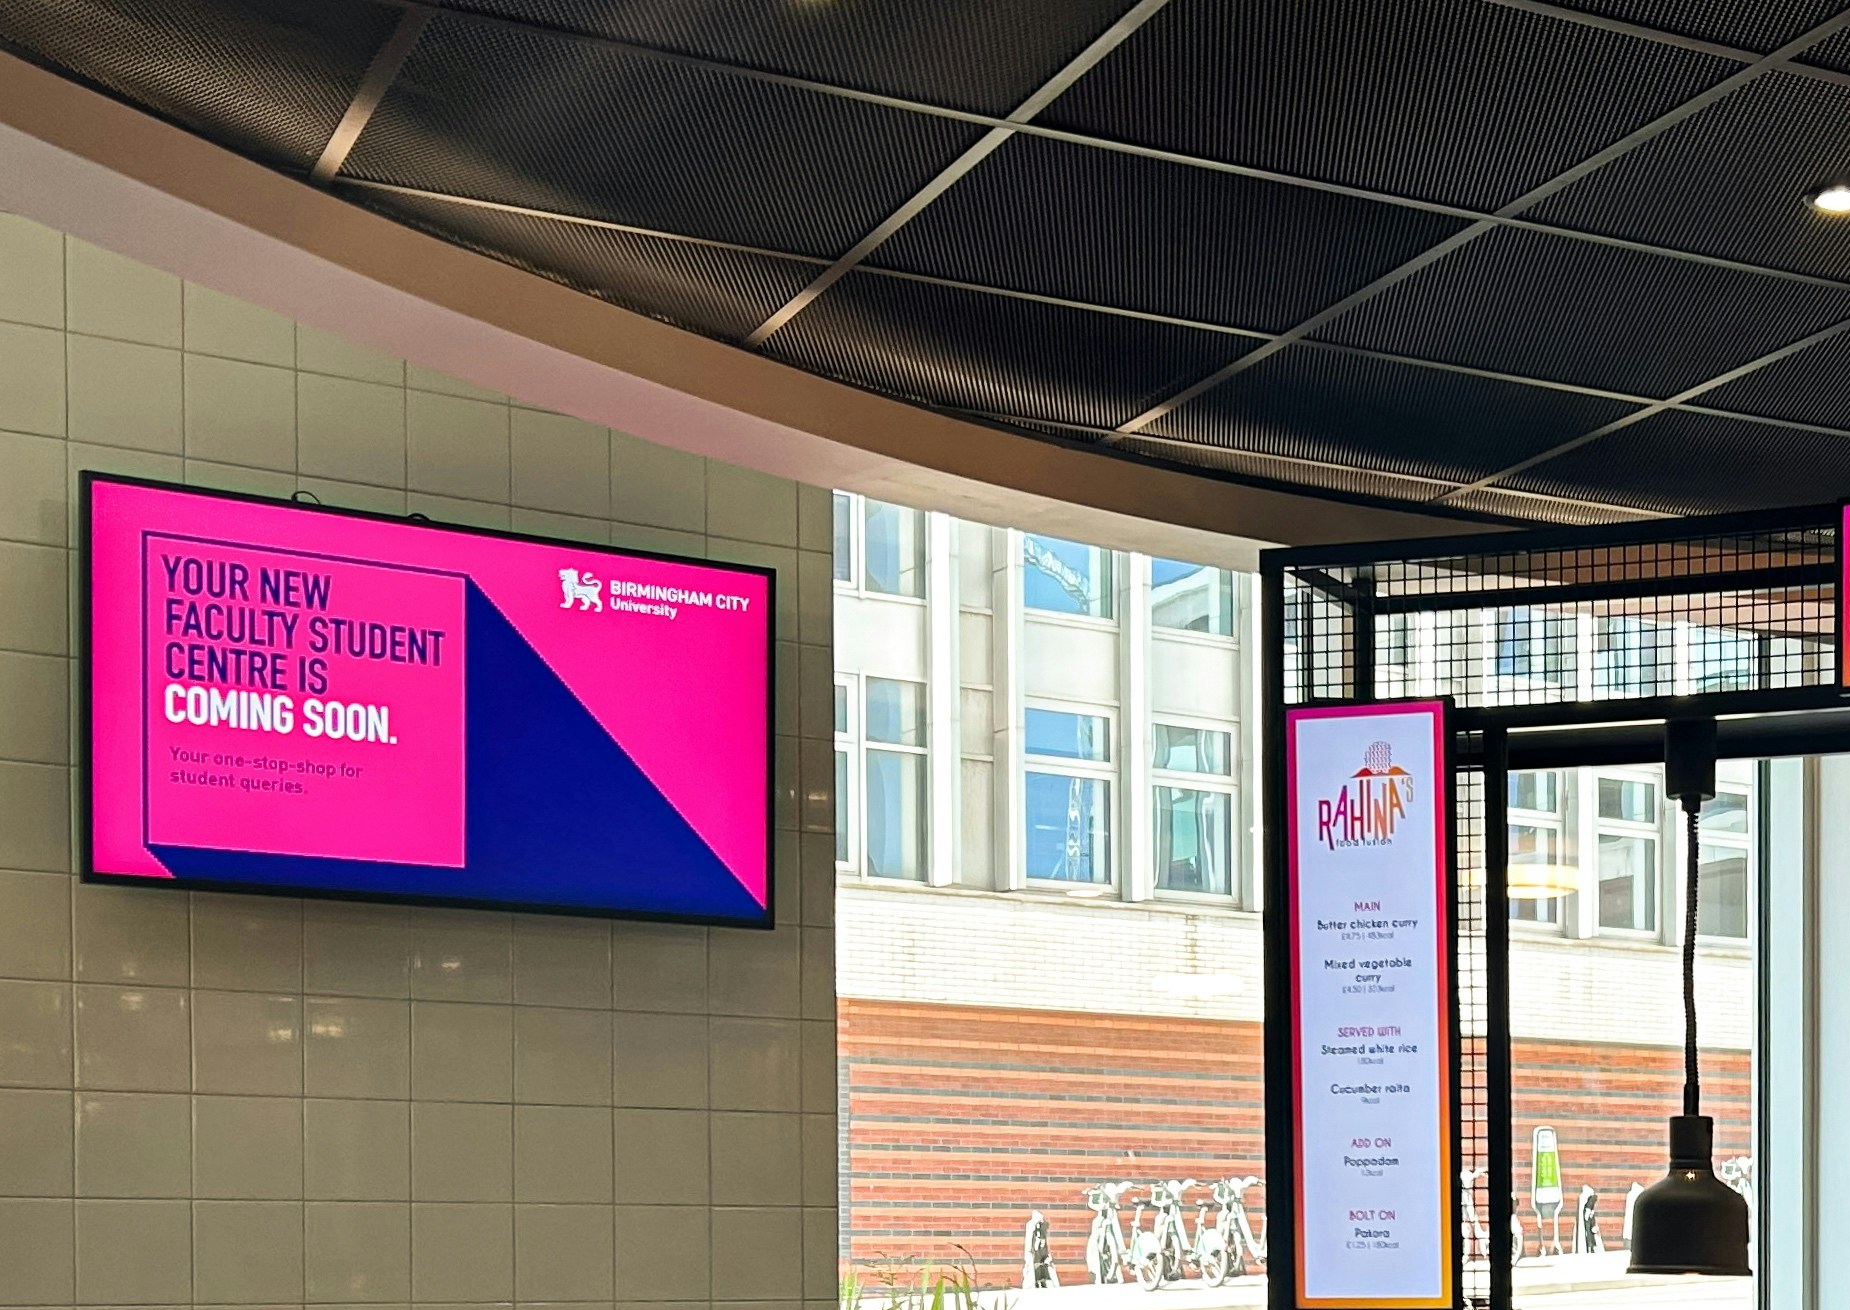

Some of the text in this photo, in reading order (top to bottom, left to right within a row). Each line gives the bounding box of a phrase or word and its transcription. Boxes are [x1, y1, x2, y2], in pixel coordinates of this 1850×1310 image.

[161, 554, 331, 611] YOUR NEW
[610, 580, 750, 612] BIRMINGHAM CITY
[610, 597, 678, 620] University
[166, 598, 445, 667] FACULTY STUDENT
[166, 642, 328, 695] CENTRE IS
[165, 683, 398, 744] COMING SOON.
[170, 746, 363, 778] Your one-stop-shop for
[170, 769, 308, 794] student queries.
[1354, 901, 1381, 911] MAIN
[1317, 919, 1418, 930] Butter chicken curry
[1324, 957, 1412, 969] Mixed vegetable
[1355, 974, 1382, 983] curry
[1337, 1026, 1401, 1038] SERVED WITH
[1321, 1043, 1418, 1055] Steamed white rice
[1330, 1083, 1410, 1094] Cucumber raita
[1351, 1137, 1392, 1148] ADD ON
[1349, 1209, 1396, 1221] BOLT ON
[1354, 1228, 1390, 1238] Pakora
